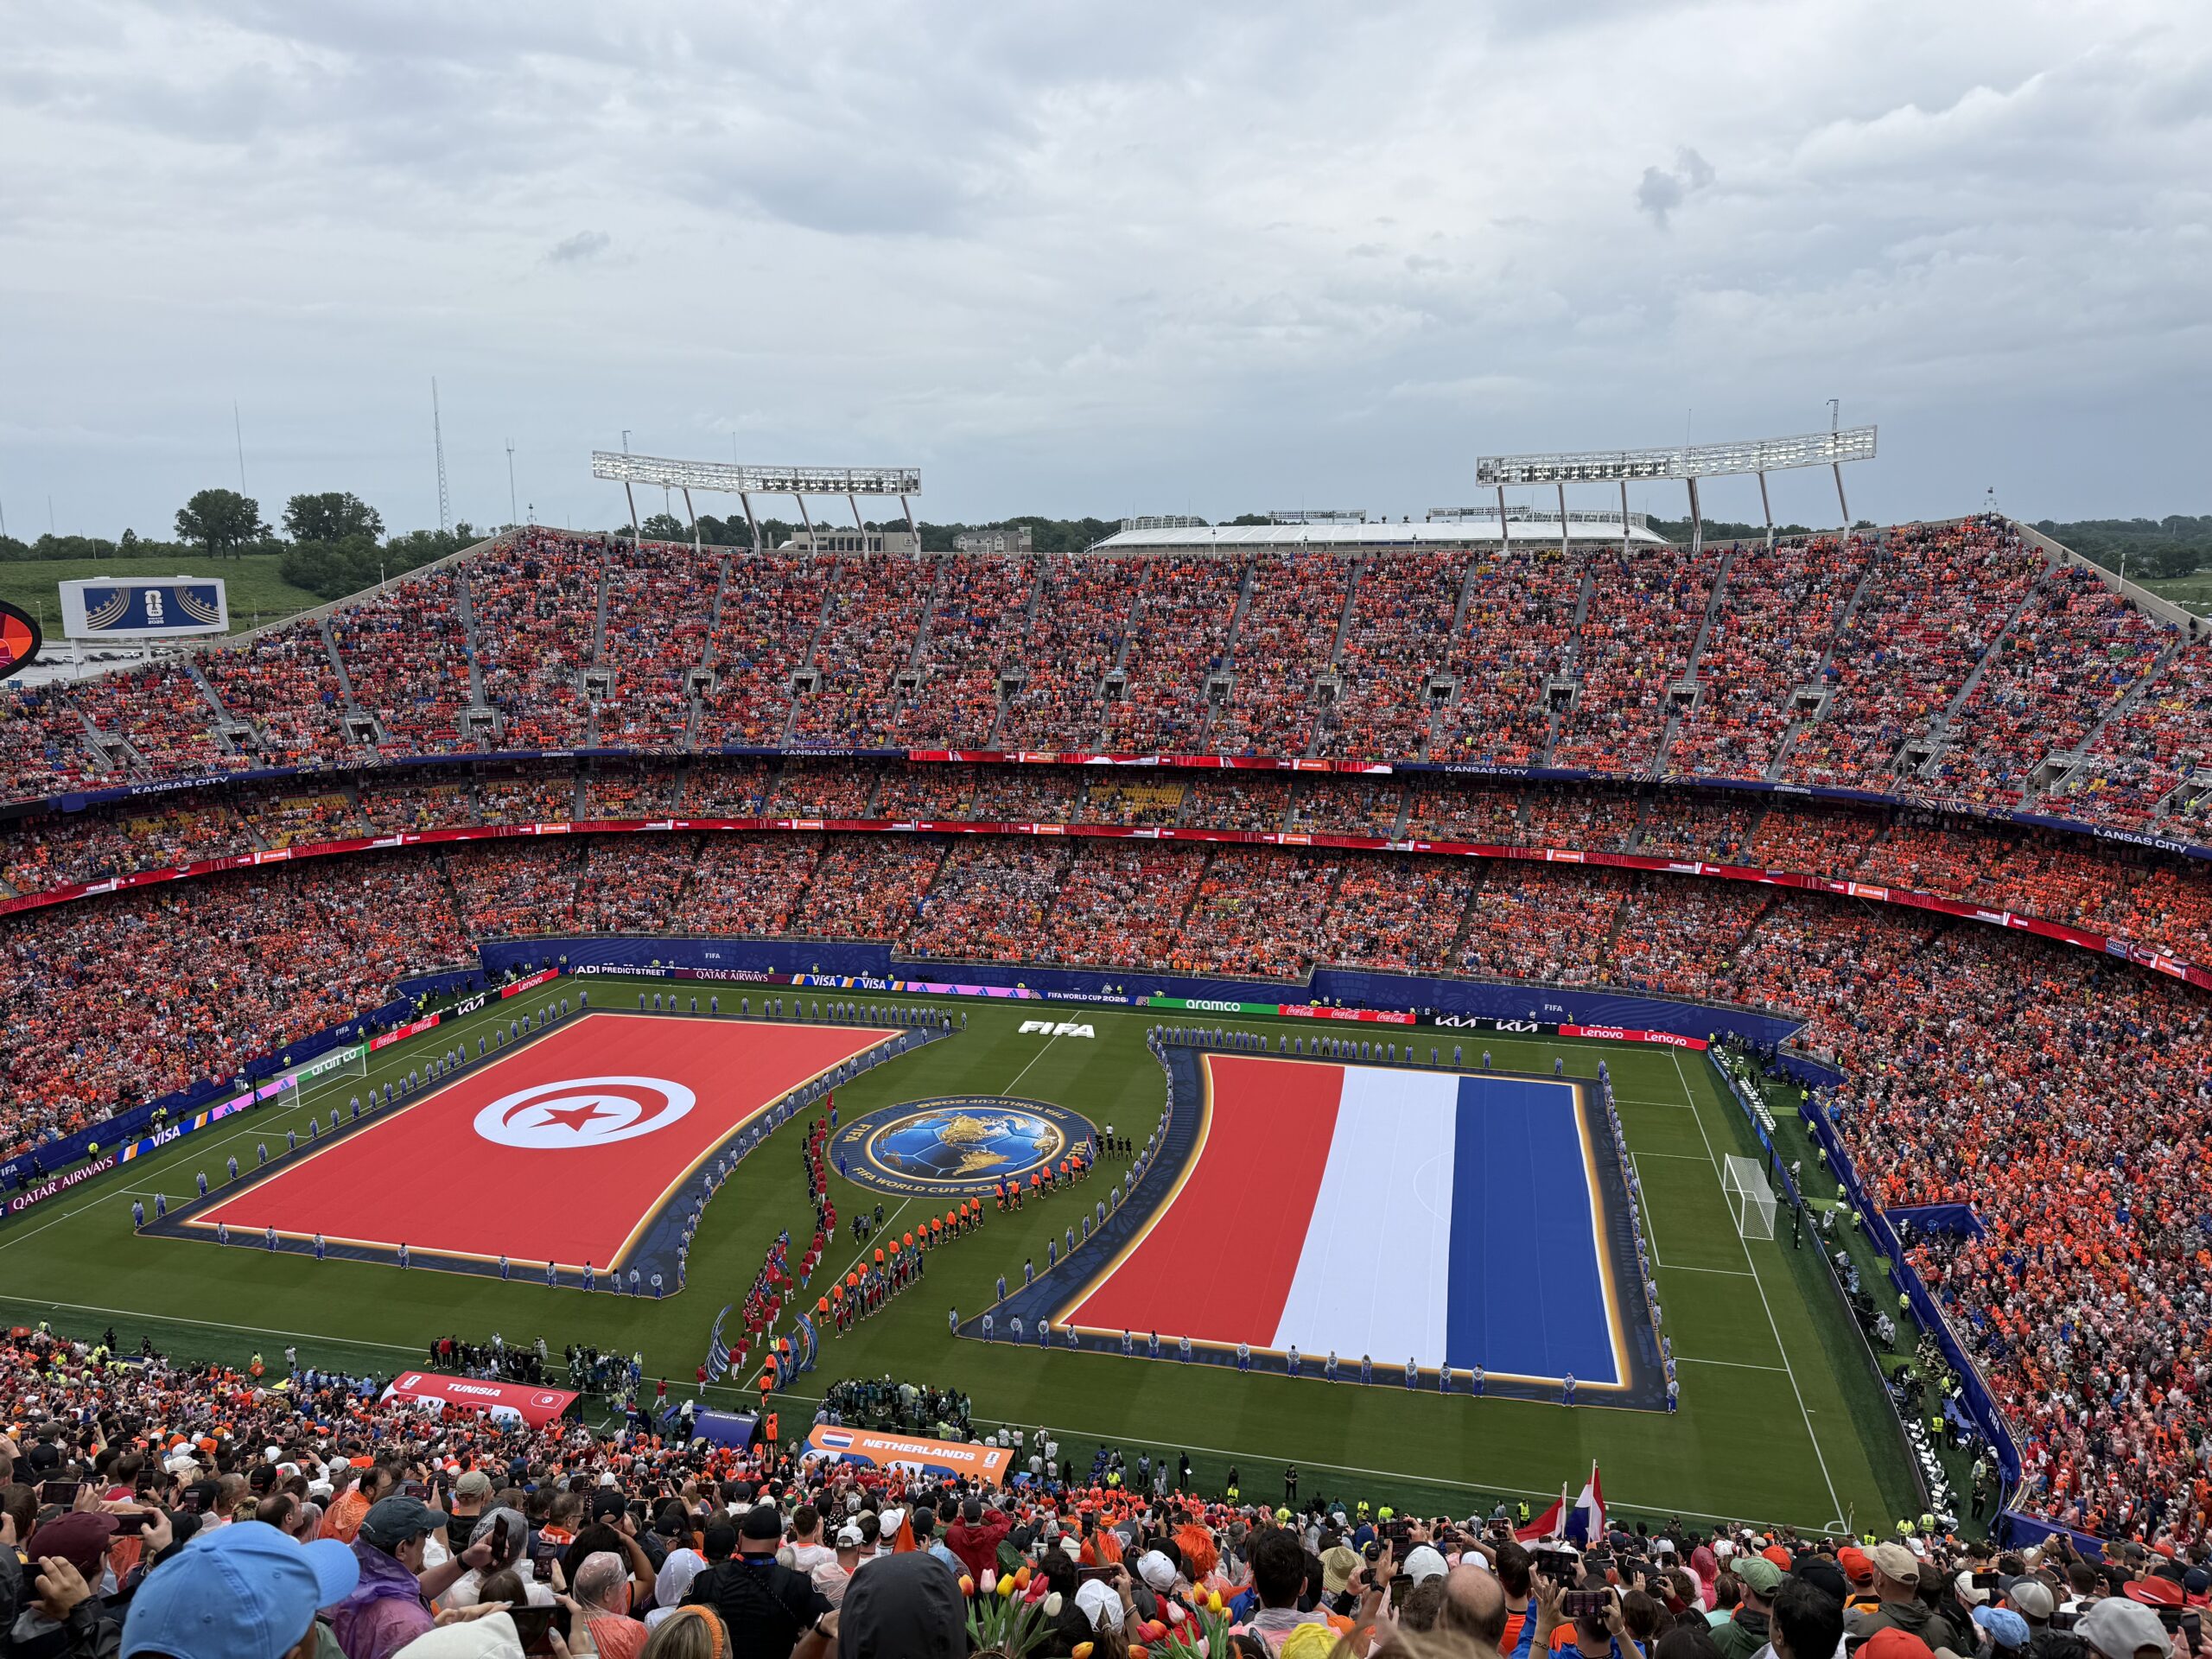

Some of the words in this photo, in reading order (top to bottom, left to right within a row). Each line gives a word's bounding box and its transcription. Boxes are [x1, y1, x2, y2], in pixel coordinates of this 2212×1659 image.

[131, 780, 192, 795] KANSAS
[195, 777, 228, 786] CITY
[1774, 785, 1811, 794] #FIFAWorldCup
[2094, 828, 2152, 845] KANSAS
[2155, 840, 2187, 854] CITY
[602, 967, 665, 976] PREDICTSTREET
[696, 971, 726, 980] QATAR
[730, 973, 767, 982] AIRWAYS
[518, 976, 543, 992] Lenovo
[812, 976, 836, 987] VISA
[862, 978, 886, 989] VISA
[458, 997, 485, 1015] KIA
[1186, 1000, 1240, 1011] aramco
[1018, 1020, 1095, 1038] FIFA
[1435, 1016, 1476, 1028] KIA
[1497, 1020, 1537, 1033] KIA
[336, 1026, 349, 1036] FIFA
[1580, 1027, 1624, 1039] Lenovo
[1645, 1032, 1687, 1046] Lenovo
[999, 1100, 1043, 1111] WORLD
[1045, 1108, 1069, 1120] FIFA
[151, 1125, 181, 1147] VISA
[842, 1123, 873, 1143] FIFA
[1065, 1141, 1087, 1160] FIFA
[0, 1164, 17, 1177] IFA
[13, 1181, 57, 1210] QATAR
[62, 1156, 113, 1188] AIRWAYS
[853, 1166, 876, 1180] FIFA
[875, 1178, 926, 1192] WORLD
[447, 1382, 501, 1396] TUNISIA
[1989, 1407, 1999, 1434] FIFA
[862, 1439, 976, 1461] NETHERLANDS
